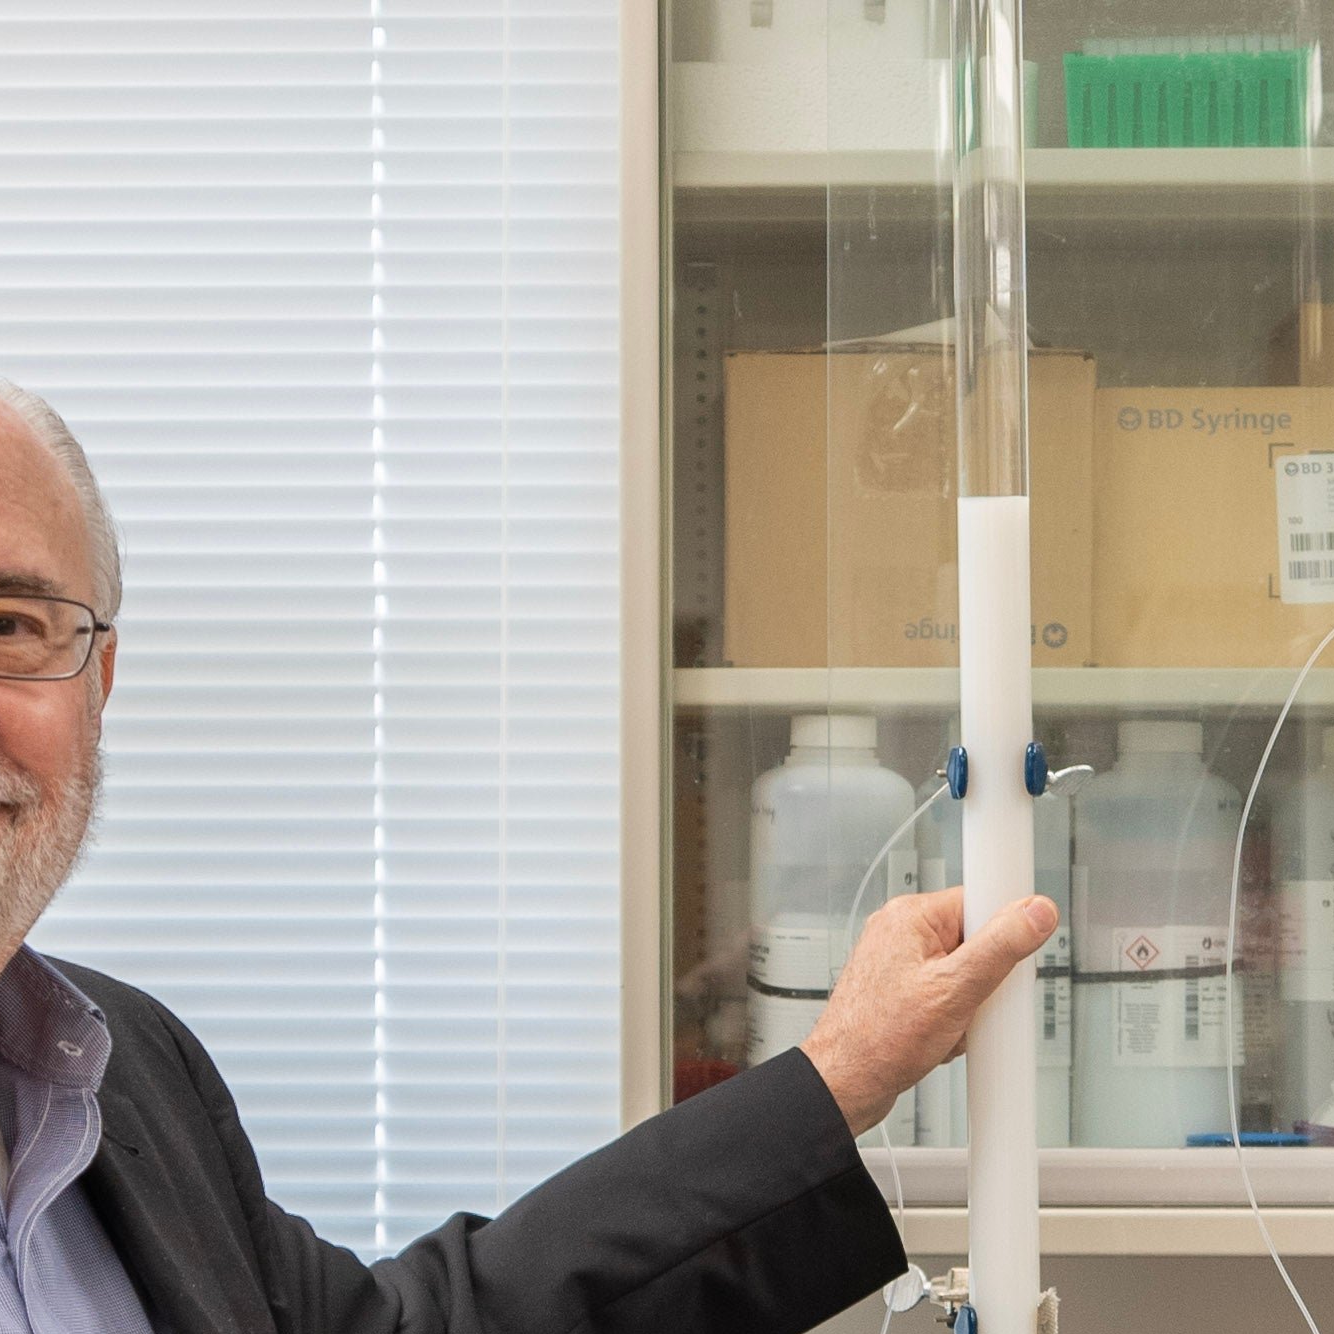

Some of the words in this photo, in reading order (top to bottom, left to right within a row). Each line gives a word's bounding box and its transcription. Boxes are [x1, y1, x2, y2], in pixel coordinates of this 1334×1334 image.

[1147, 408, 1184, 430] BD
[1191, 407, 1292, 435] Syringe
[1301, 462, 1322, 475] BD
[904, 618, 960, 644] inge
